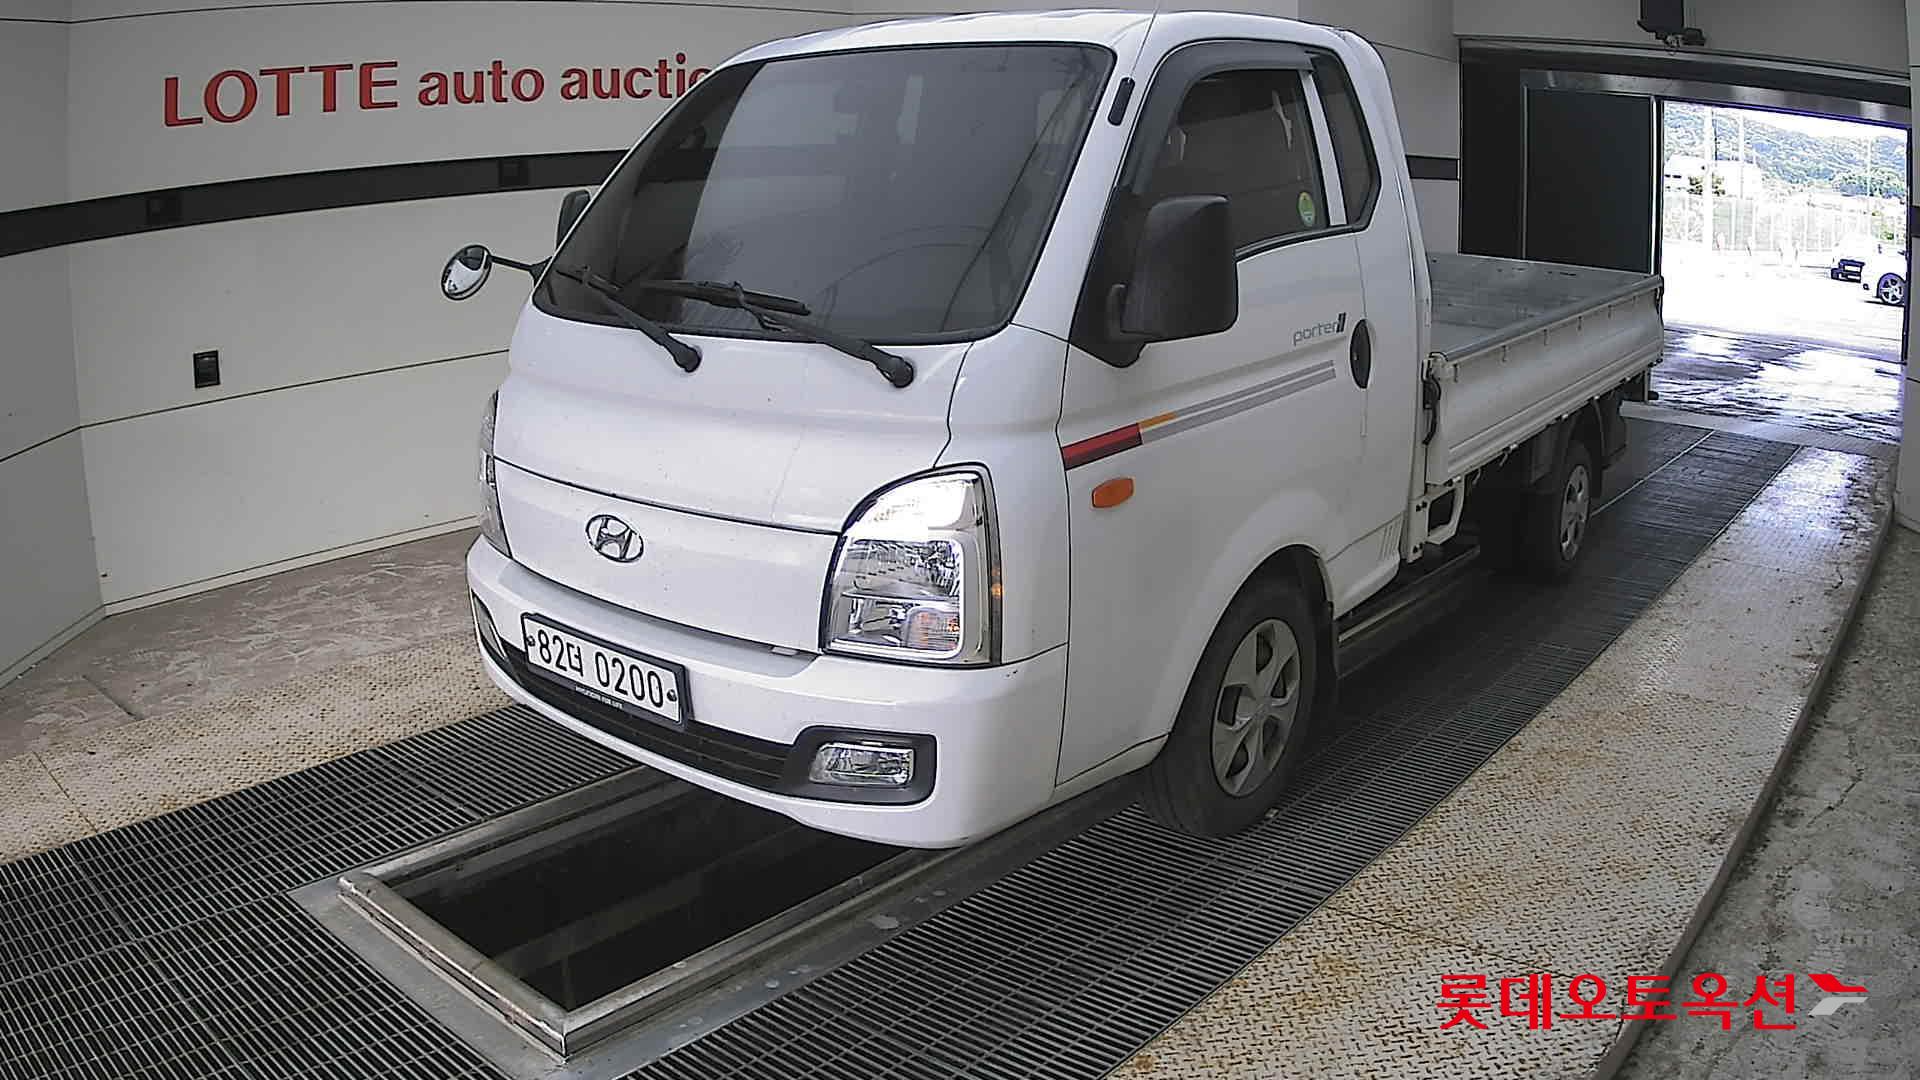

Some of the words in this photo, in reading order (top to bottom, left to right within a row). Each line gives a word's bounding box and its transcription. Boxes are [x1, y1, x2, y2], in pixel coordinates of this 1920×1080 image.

[164, 61, 398, 127] LOTTE
[418, 60, 545, 105] auto
[537, 629, 584, 677] 82더
[595, 651, 663, 708] 0200
